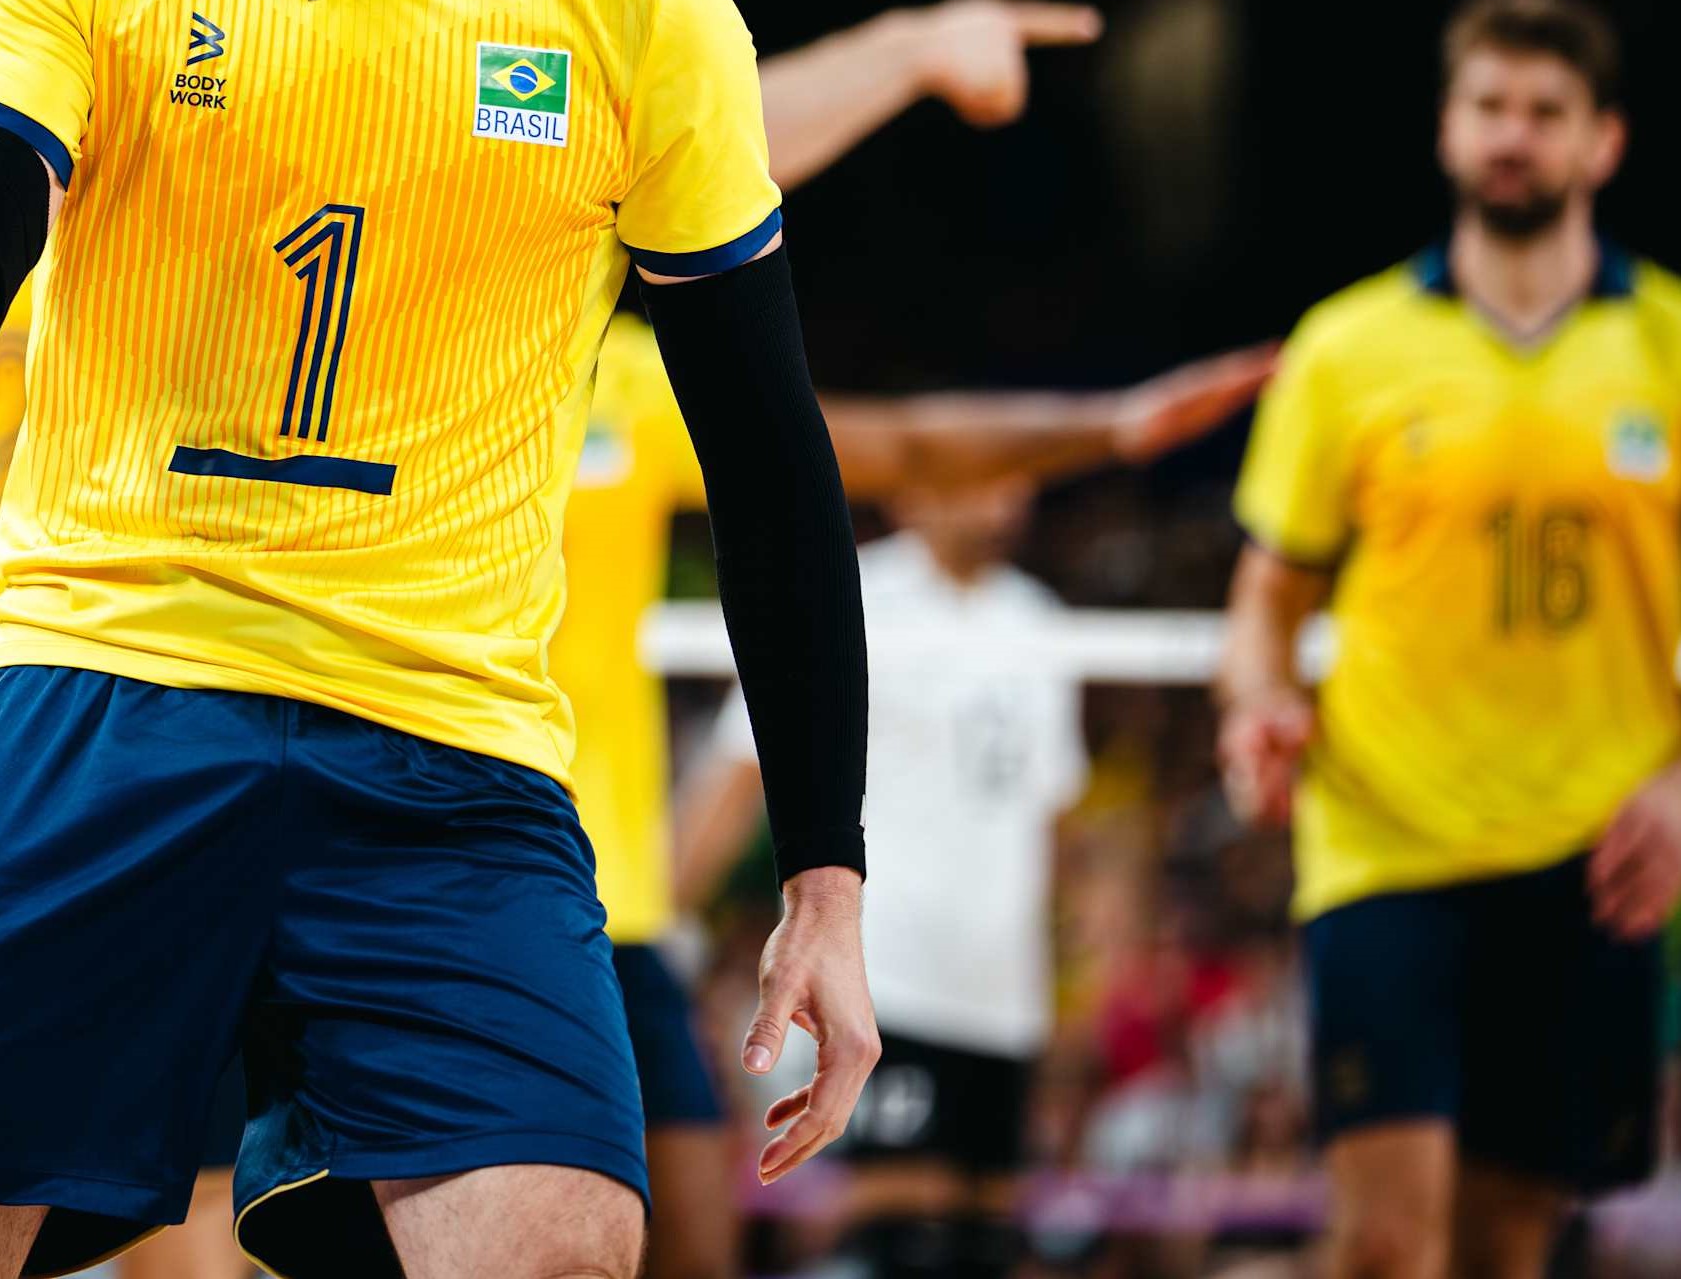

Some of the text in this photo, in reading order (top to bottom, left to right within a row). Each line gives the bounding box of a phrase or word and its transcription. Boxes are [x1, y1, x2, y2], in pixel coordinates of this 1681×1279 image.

[170, 89, 227, 110] WORK
[175, 74, 227, 92] BODY
[476, 108, 564, 141] BRASIL
[273, 204, 365, 442] 1
[1484, 497, 1590, 637] 16
